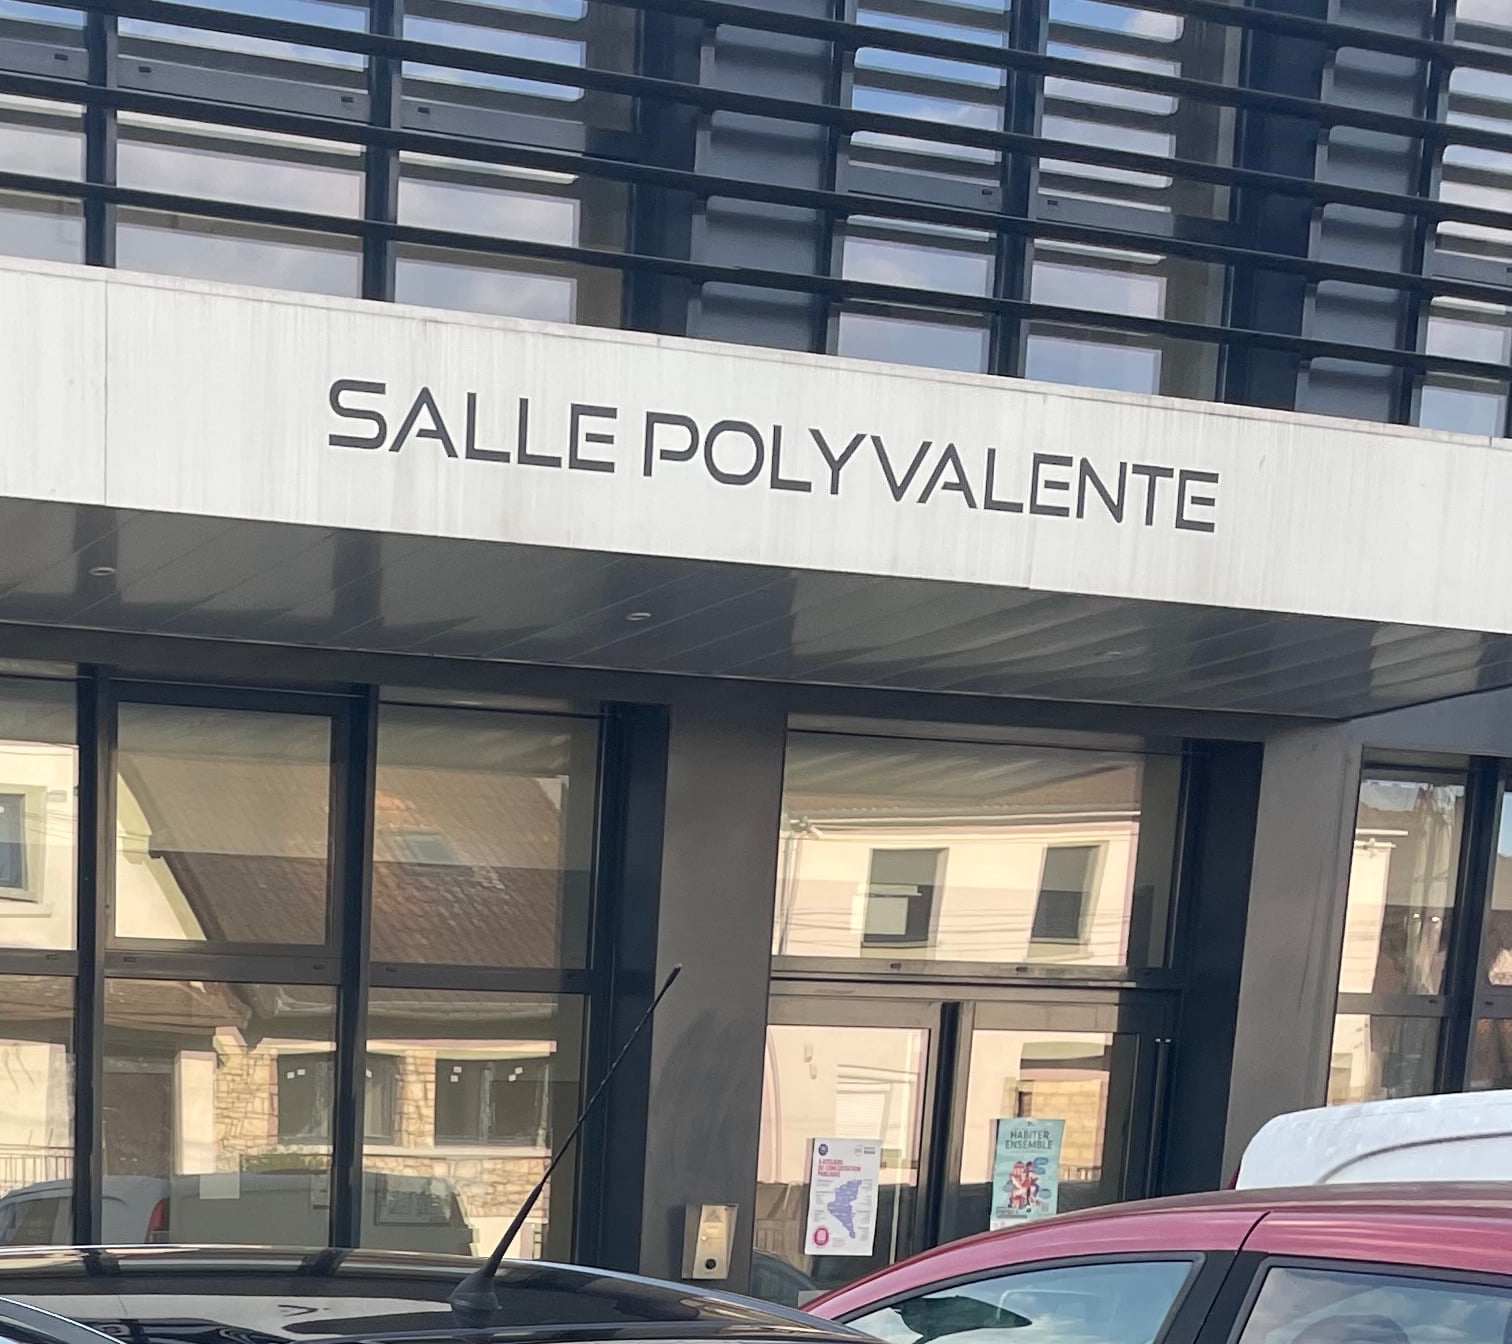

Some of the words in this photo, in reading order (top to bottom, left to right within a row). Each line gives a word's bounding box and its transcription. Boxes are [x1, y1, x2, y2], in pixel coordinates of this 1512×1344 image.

[328, 378, 618, 473] SALLE
[643, 411, 1220, 532] POLYVALENTE
[1005, 1139, 1053, 1149] ENSEMBLE
